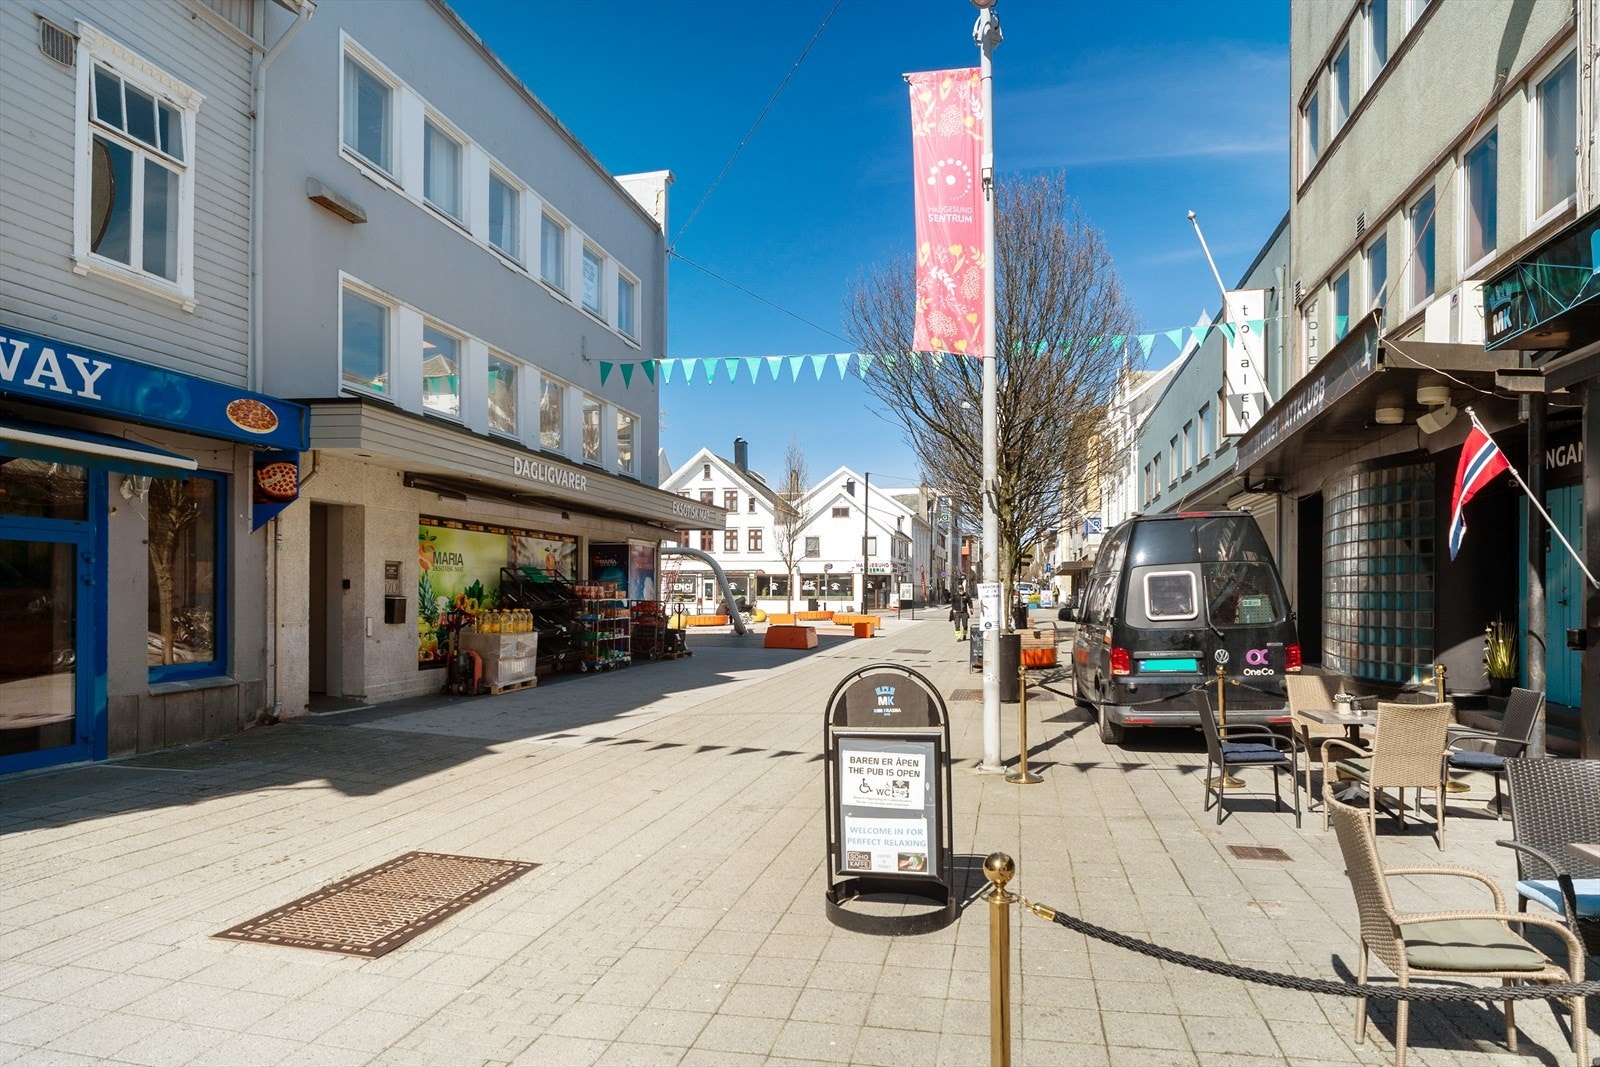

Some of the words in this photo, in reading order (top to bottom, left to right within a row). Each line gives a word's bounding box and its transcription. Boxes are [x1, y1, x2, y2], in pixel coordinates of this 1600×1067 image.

[929, 206, 973, 214] HAUGESUND
[929, 214, 973, 223] SENTRUM
[1492, 305, 1513, 336] MK
[1240, 304, 1250, 420] toalen
[514, 456, 587, 492] DAGLIGVARER
[672, 501, 699, 519] EKSOTISK
[699, 508, 711, 521] MAT
[433, 551, 464, 566] MARIA
[1243, 667, 1275, 676] OneCo
[877, 695, 895, 706] MK
[849, 756, 880, 765] BAREN
[882, 757, 893, 766] ER
[895, 757, 919, 767] ÅPEN
[848, 766, 864, 775] THE
[867, 767, 884, 776] PUB
[886, 768, 894, 776] IS
[896, 769, 921, 778] OPEN
[876, 788, 891, 797] WC
[849, 826, 892, 835] WELCOME
[906, 828, 924, 836] FOR
[847, 837, 881, 846] PERFECT
[884, 839, 926, 847] RELAXING
